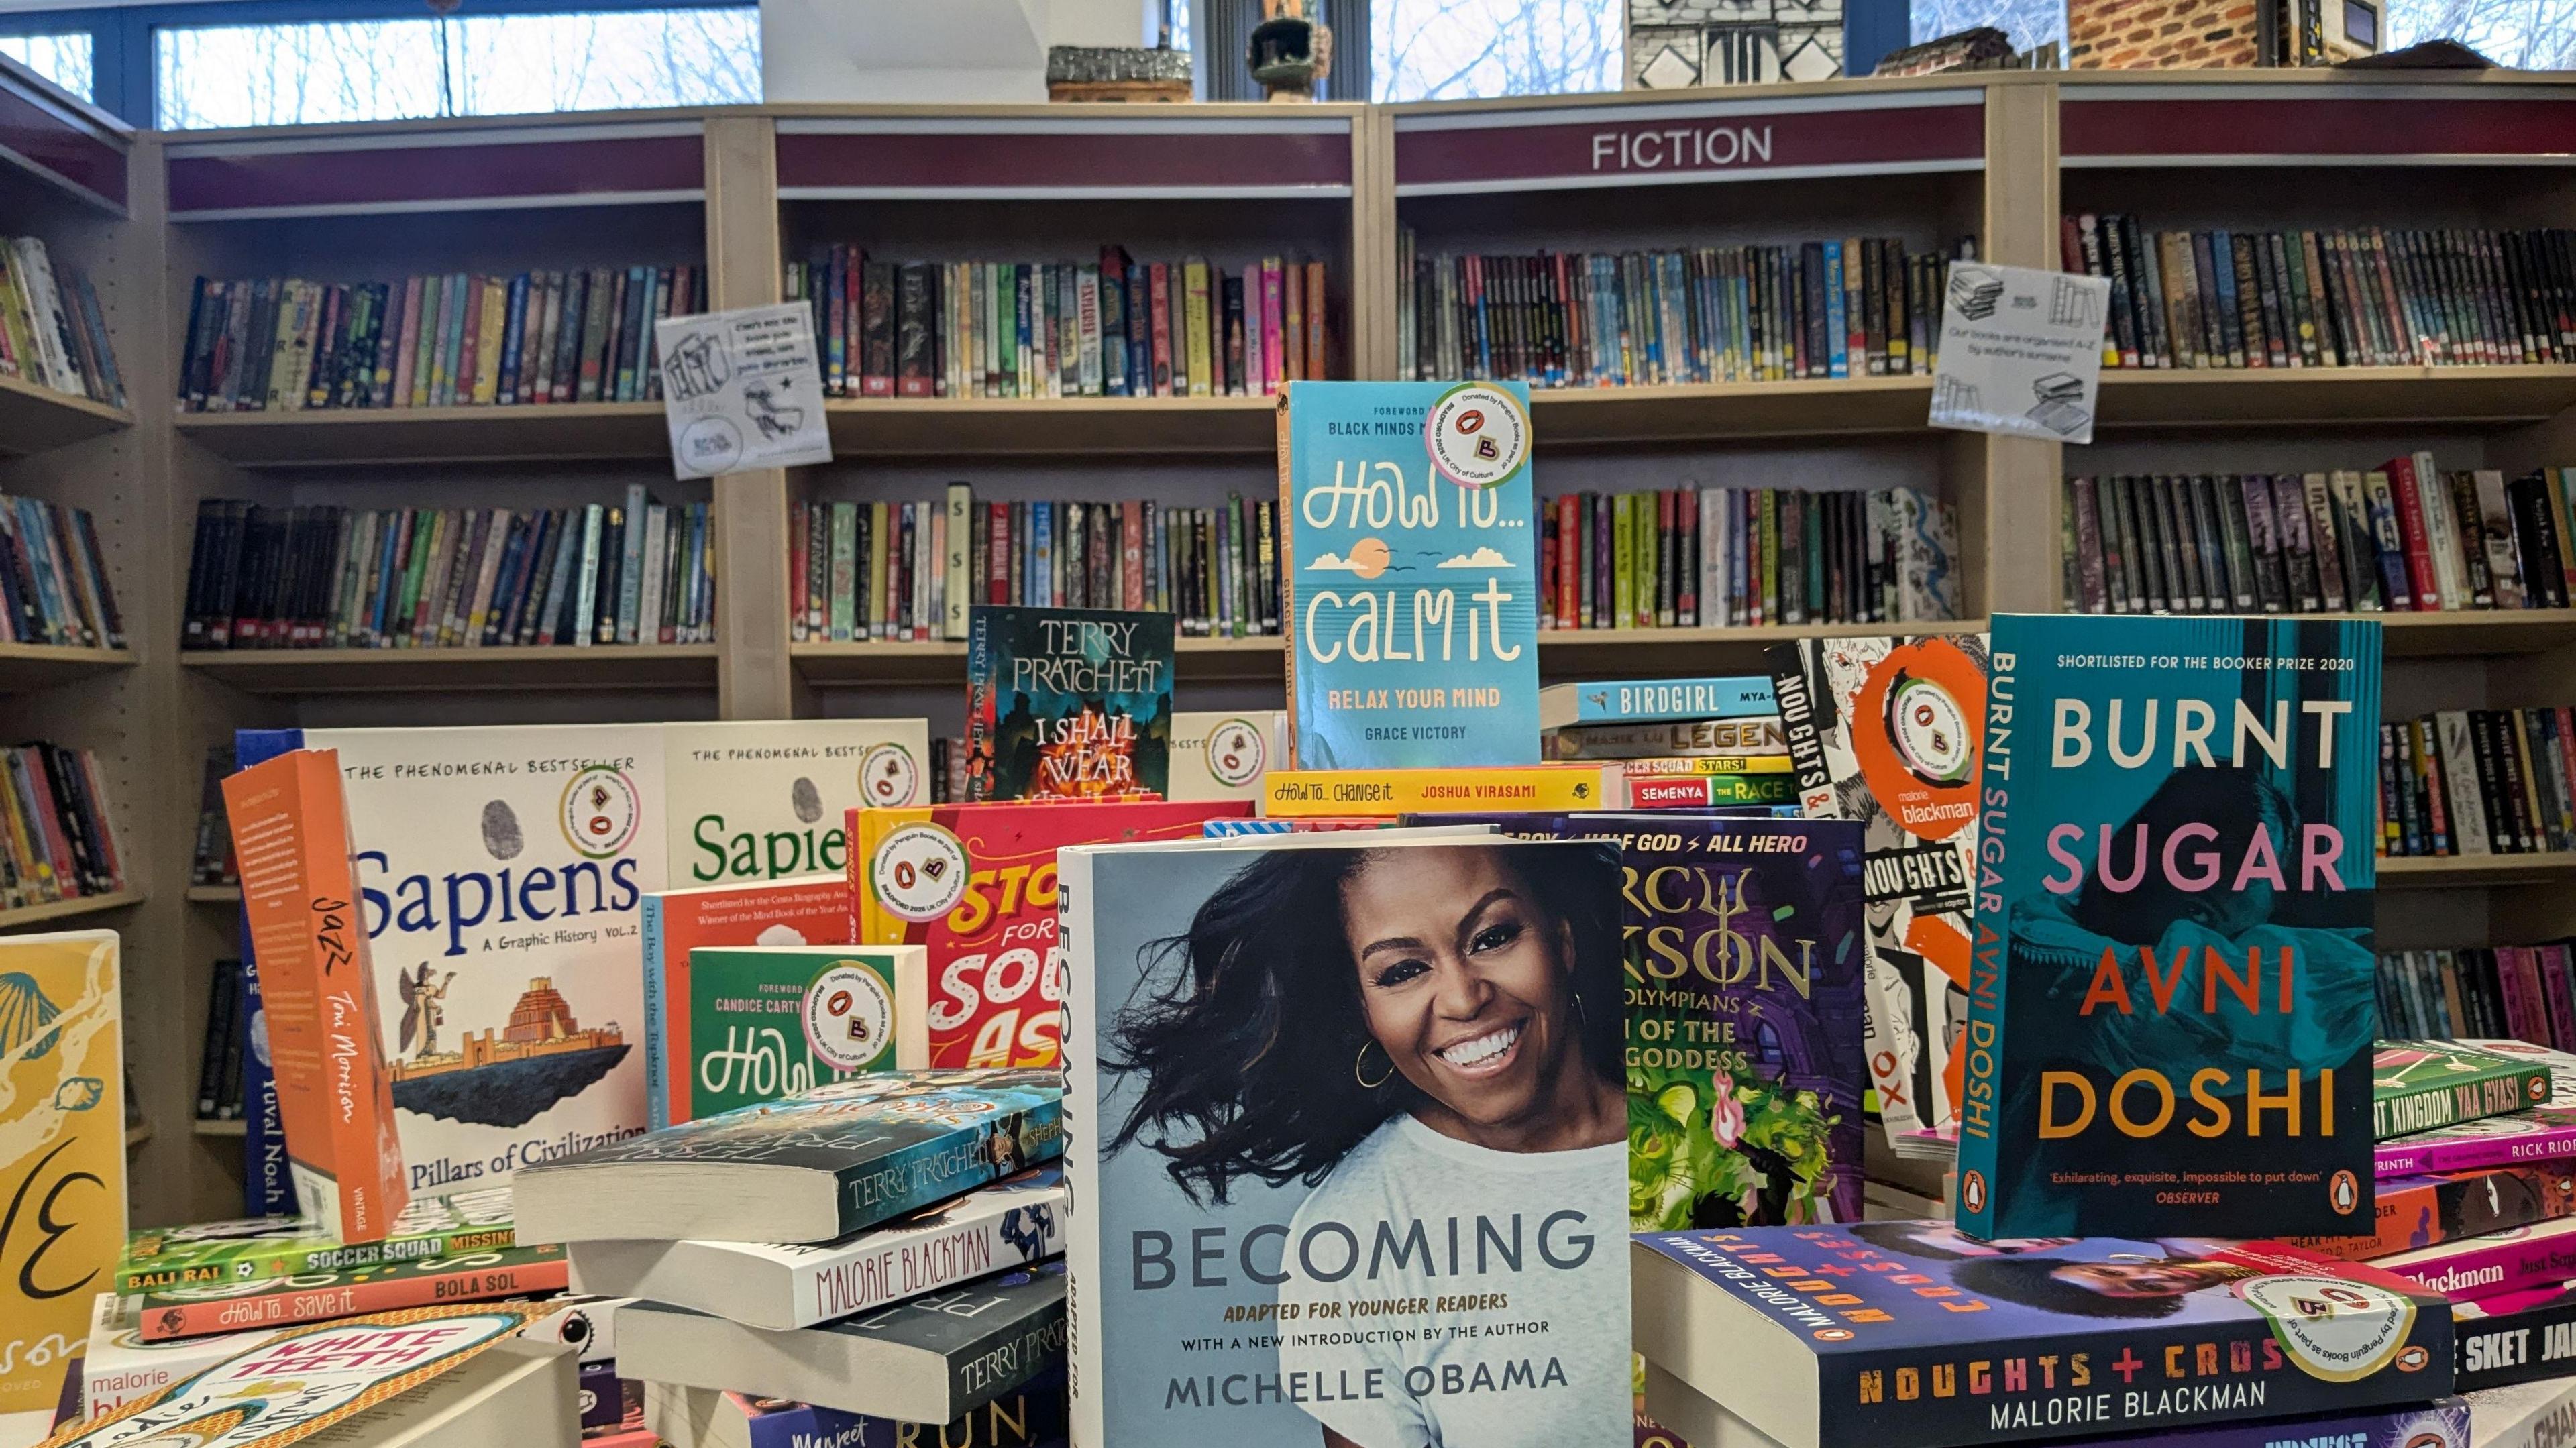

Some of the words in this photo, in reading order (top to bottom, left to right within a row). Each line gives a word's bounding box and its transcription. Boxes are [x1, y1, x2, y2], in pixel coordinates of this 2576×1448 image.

[1593, 125, 1772, 170] FICTION
[1328, 422, 1371, 436] BLACK
[1374, 421, 1415, 435] MINDS
[1373, 406, 1425, 416] FOREWORD
[1462, 394, 1490, 402] Donated
[1489, 396, 1497, 405] by
[1497, 400, 1516, 423] Penguin
[1512, 422, 1521, 443] Books
[1039, 620, 1140, 657] TERRY
[1011, 657, 1162, 694] PRATCHETT
[2057, 653, 2146, 670] SHORTLISTED
[2151, 654, 2179, 670] FOR
[2182, 655, 2208, 670] THE
[2213, 655, 2273, 671] BOOKER
[2277, 656, 2315, 671] PRIZE
[2320, 657, 2355, 671] 2020
[1328, 689, 1388, 710] RELAX
[1395, 689, 1444, 708] YOUR
[1452, 688, 1500, 708] MIND
[1621, 685, 1719, 714] BIRDGIRL
[1987, 651, 2016, 780] BURNT
[1035, 718, 1046, 746] I
[1050, 710, 1138, 748] SHALL
[1365, 726, 1407, 740] GRACE
[1411, 725, 1466, 740] VICTORY
[1670, 722, 1788, 750] LEGEN
[1776, 674, 1825, 788] NOUGHTS
[1806, 793, 1830, 811] &
[2050, 698, 2353, 770] BURNT
[345, 765, 385, 780] THE
[394, 760, 518, 778] PHENOMENAL
[692, 749, 722, 761] THE
[728, 747, 818, 761] PHENOMENAL
[1042, 749, 1132, 785] WEAR
[1652, 760, 1693, 774] SQUAD
[1698, 758, 1746, 771] STARS!
[1421, 785, 1472, 799] JOSHUA
[1475, 785, 1536, 799] VIRASAMI
[1642, 787, 1704, 800] SEMENYA
[1717, 788, 1731, 796] THE
[1735, 783, 1784, 801] RACE
[1898, 790, 1929, 803] malorie
[1901, 802, 1974, 824] blackman
[1636, 834, 1682, 852] GOD
[1706, 834, 1743, 853] ALL
[1748, 835, 1807, 854] HERO
[1976, 787, 2007, 913] SUGAR
[2041, 822, 2347, 895] SUGAR
[1865, 849, 1963, 897] NOUGHTS
[356, 850, 640, 957] Sapiens
[701, 899, 743, 910] Shortlisted
[744, 897, 756, 907] for
[757, 897, 770, 906] the
[771, 894, 793, 905] Costa
[794, 892, 831, 904] Biography
[947, 862, 1059, 934] STO
[646, 903, 655, 932] The
[1000, 917, 1055, 947] FOR
[483, 939, 494, 953] A
[498, 933, 550, 955] Graphic
[553, 927, 598, 948] History
[645, 936, 656, 965] Boy
[647, 966, 657, 1000] with
[1976, 922, 2000, 1010] AVNI
[2079, 946, 2293, 1016] AVNI
[715, 999, 763, 1013] CANDICE
[766, 999, 802, 1013] CARTY
[759, 984, 802, 994] FOREWORD
[1624, 989, 1741, 1013] OLYMPIANS
[327, 990, 357, 1028] Toni
[649, 1001, 658, 1025] the
[1640, 1020, 1675, 1042] OF
[1680, 1021, 1736, 1044] THE
[648, 1031, 661, 1088] Topknot
[1058, 883, 1076, 1219] BECOMING
[1626, 1047, 1748, 1071] GODDESS
[330, 1033, 359, 1125] Morrison
[1965, 1020, 1996, 1139] DOSHI
[262, 1080, 283, 1137] Yuval
[2038, 1067, 2334, 1140] DOSHI
[2391, 1087, 2453, 1133] KINGDOM
[2455, 1082, 2481, 1118] YAA
[2483, 1076, 2520, 1115] GYASI
[411, 1151, 484, 1190] Pillars
[488, 1143, 518, 1178] of
[521, 1126, 647, 1164] Civilization
[2512, 1142, 2544, 1158] RICK
[264, 1143, 285, 1204] Noah
[849, 1166, 908, 1209] TERRY
[2123, 1172, 2180, 1186] exquisite,
[2183, 1171, 2247, 1185] impossible
[2250, 1172, 2263, 1183] to
[2265, 1172, 2285, 1186] put
[353, 1186, 368, 1232] VINTAGE
[2156, 1191, 2220, 1205] OBSERVER
[307, 1245, 380, 1272] SOCCER
[382, 1236, 443, 1262] SQUAD
[1131, 1209, 1595, 1290] BECOMING
[1658, 1235, 1758, 1281] BLACKMAN
[2347, 1237, 2383, 1252] TAYLOR
[127, 1270, 176, 1290] BALI
[183, 1266, 220, 1283] RAI
[434, 1278, 482, 1299] BOLA
[486, 1274, 520, 1292] SOL
[816, 1251, 894, 1317] MALORIE
[902, 1227, 991, 1294] BLACKMAN
[1699, 1234, 1896, 1325] NOUGHTS
[1792, 1231, 1992, 1313] CROSSES
[1223, 1303, 1301, 1323] ADAPTED
[1307, 1300, 1342, 1320] FOR
[1348, 1296, 1430, 1318] YOUNGER
[1435, 1292, 1509, 1314] READERS
[1739, 1280, 1836, 1327] MALORIE
[266, 1326, 470, 1359] WHITE
[1181, 1337, 1225, 1352] WITH
[1231, 1337, 1242, 1349] A
[1248, 1335, 1285, 1349] NEW
[1291, 1329, 1416, 1347] INTRODUCTION
[1423, 1326, 1444, 1340] BY
[1448, 1324, 1479, 1339] THE
[1483, 1320, 1551, 1337] AUTHOR
[2466, 1329, 2530, 1372] SKET
[92, 1368, 168, 1394] malorie
[230, 1347, 431, 1380] TEETH
[960, 1339, 1020, 1396] TERRY
[1859, 1352, 2091, 1406] NOUGHTS
[2164, 1342, 2283, 1378] CROS
[1164, 1368, 1384, 1410] MICHELLE
[1403, 1355, 1569, 1398] OBAMA
[1990, 1393, 2112, 1431] MALORIE
[2124, 1380, 2266, 1417] BLACKMAN
